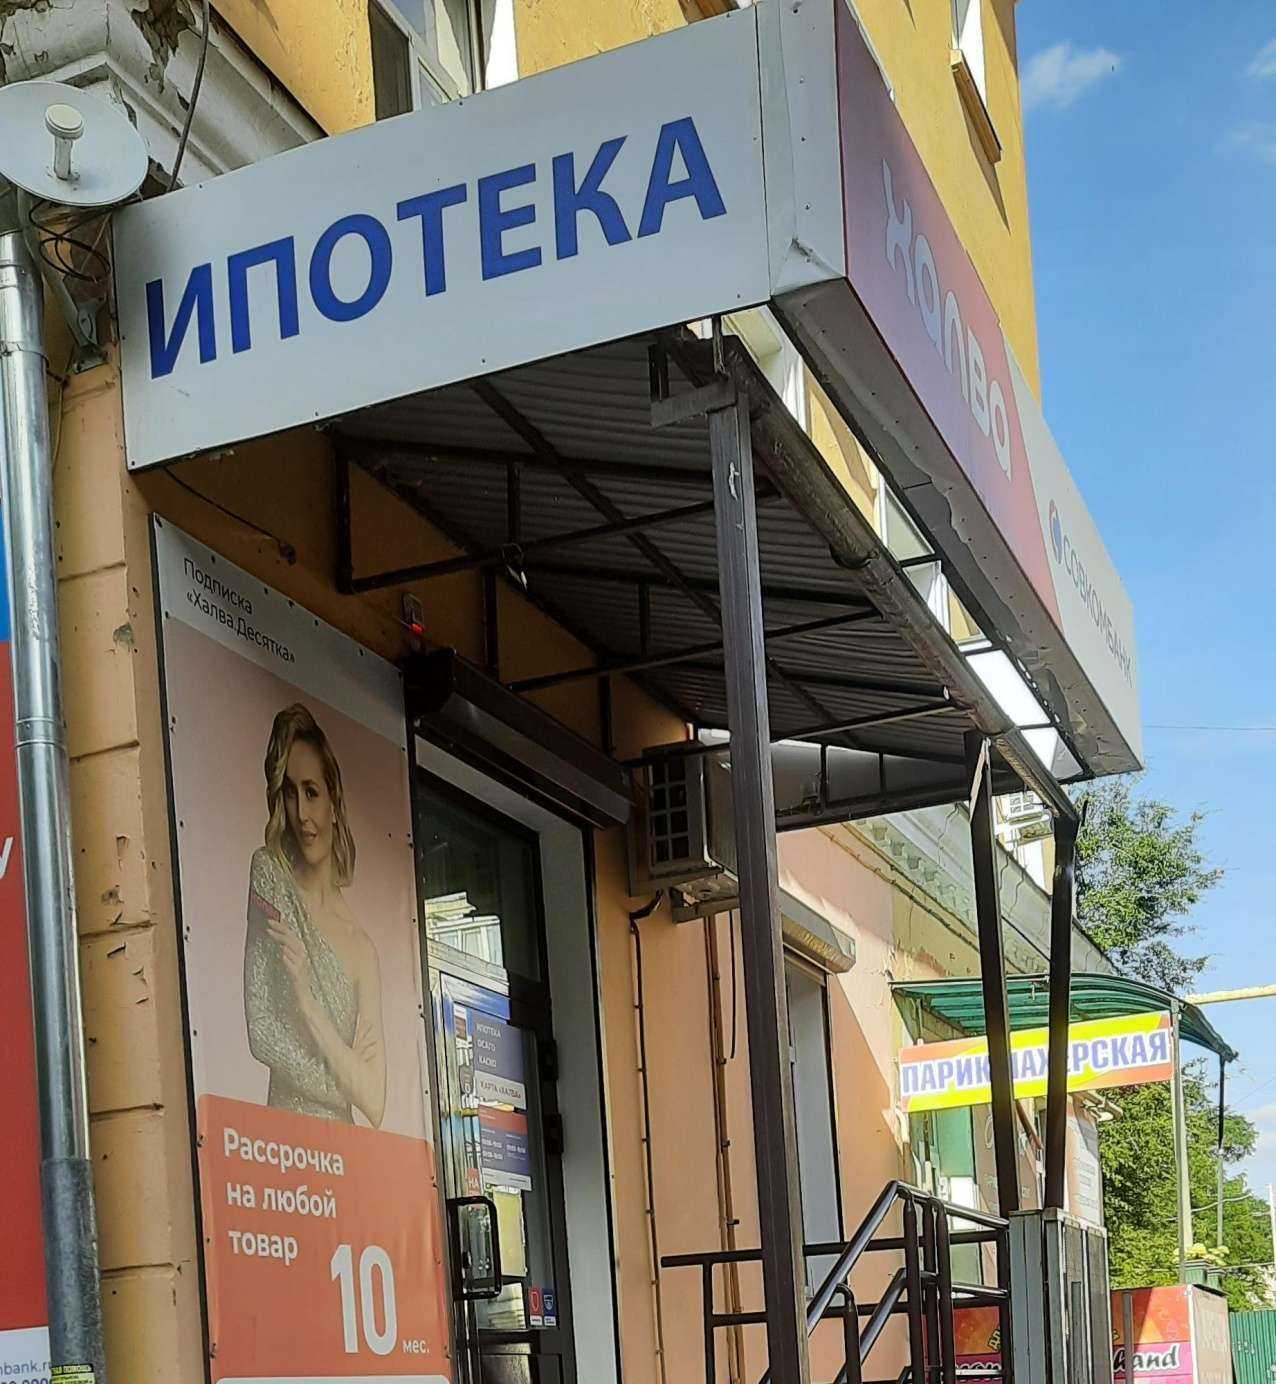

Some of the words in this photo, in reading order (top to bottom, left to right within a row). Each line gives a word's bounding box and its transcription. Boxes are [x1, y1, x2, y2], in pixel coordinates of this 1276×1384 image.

[145, 116, 727, 380] ИПОТЕКА
[184, 557, 253, 615] Подписка
[1063, 534, 1133, 689] СОВКОМБАНК
[901, 1031, 1169, 1094] ПАРИКАХРСКАЯ
[223, 1127, 344, 1176] Рассрочка
[226, 1182, 256, 1208] на
[262, 1184, 337, 1218] любой
[228, 1230, 298, 1265] товар
[331, 1244, 398, 1356] 10
[403, 1339, 430, 1354] мес.
